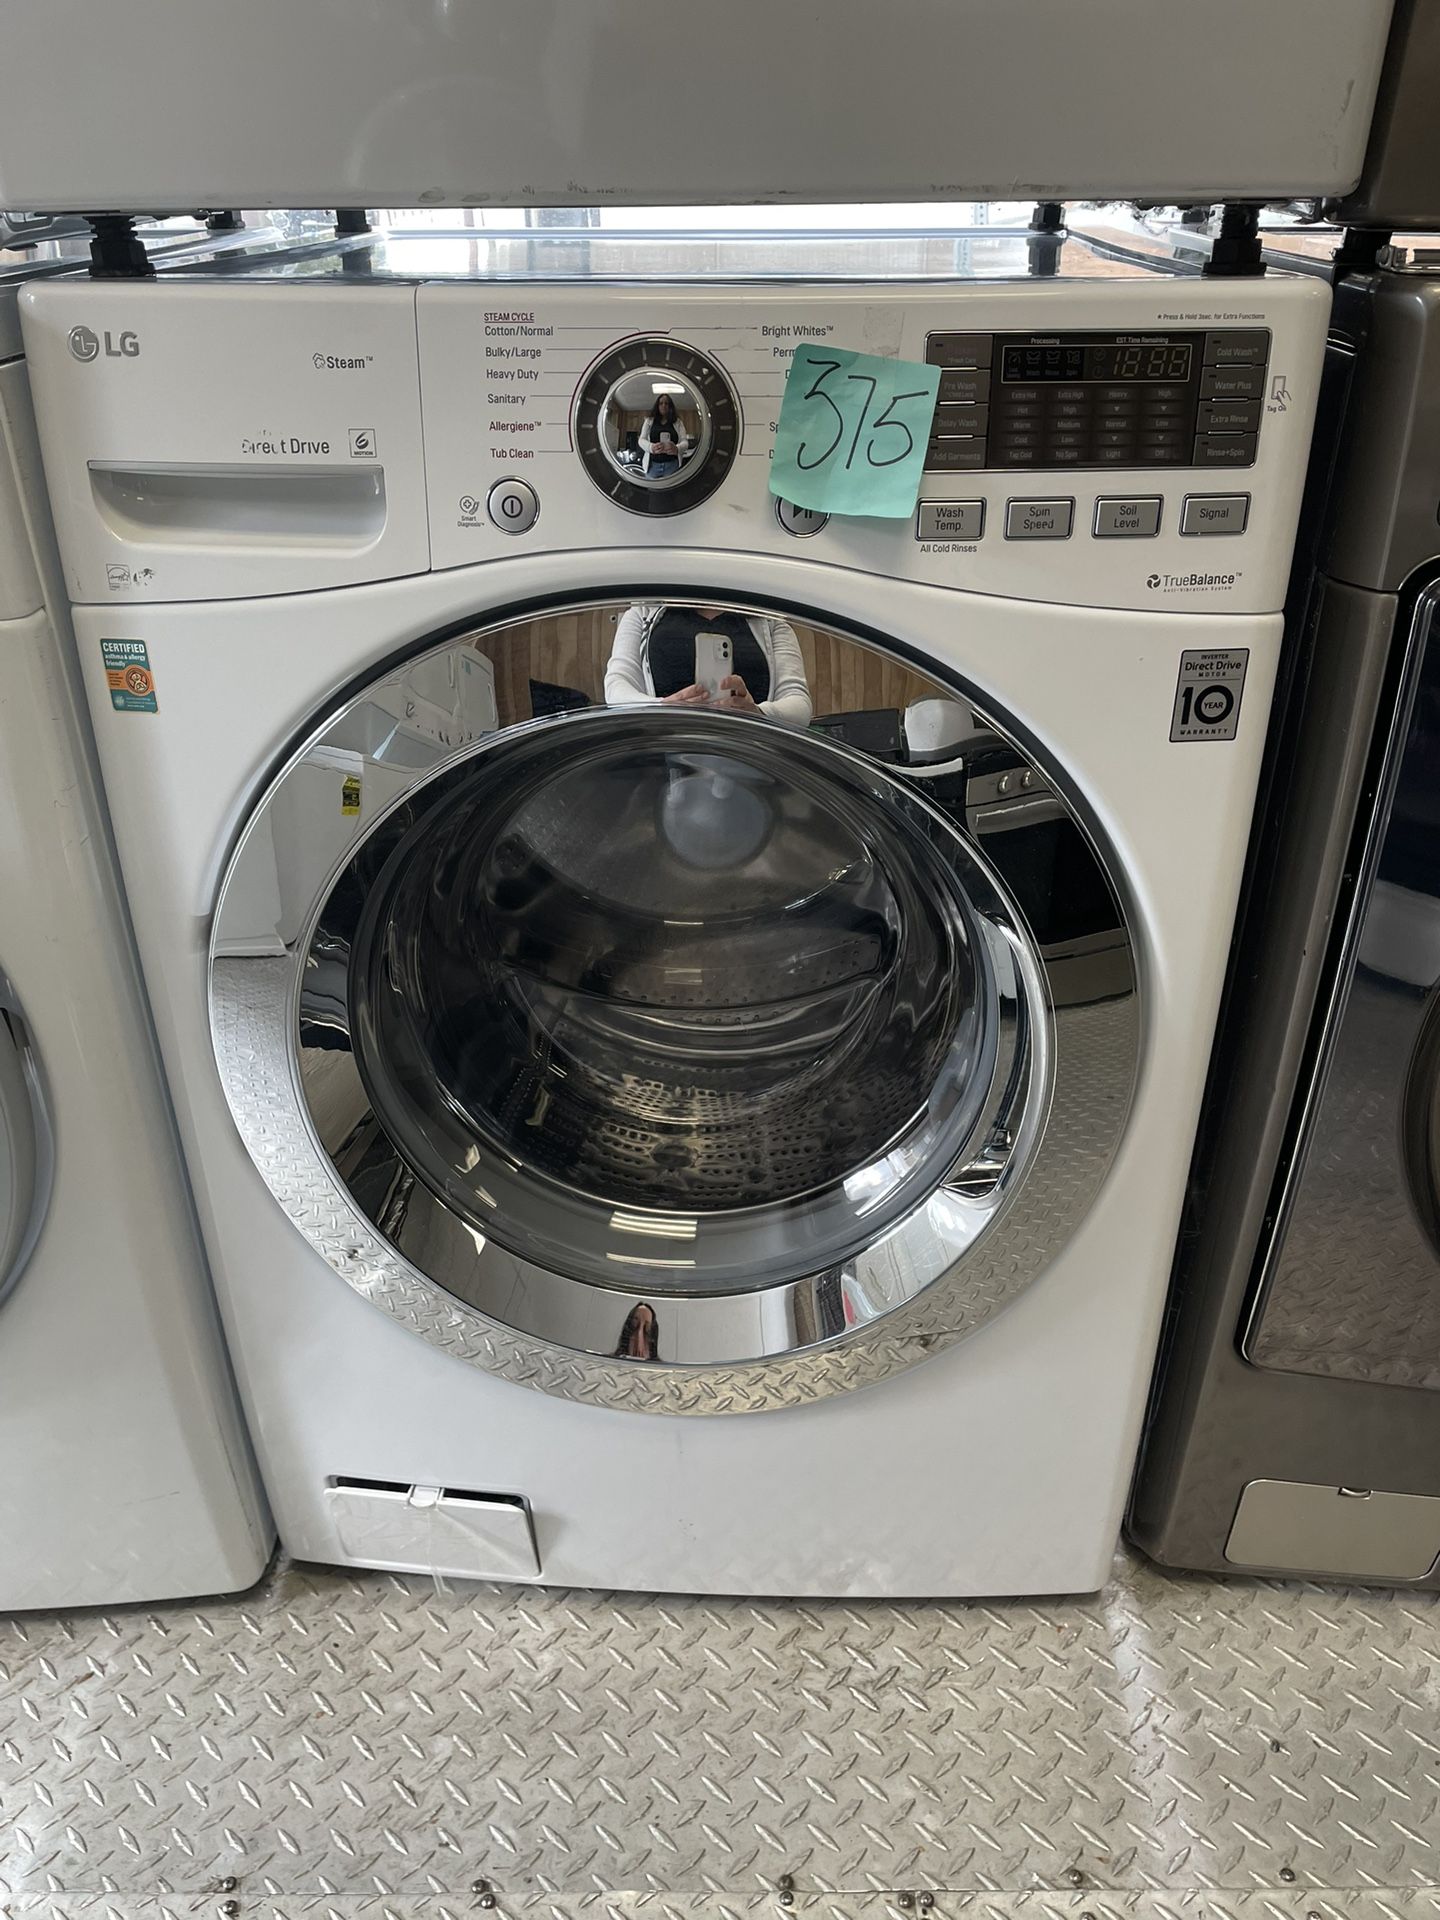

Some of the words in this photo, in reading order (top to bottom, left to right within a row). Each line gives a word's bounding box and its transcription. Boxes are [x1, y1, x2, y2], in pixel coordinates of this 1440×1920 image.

[484, 313, 511, 321] STEAM
[511, 313, 534, 321] CYCLE
[484, 326, 554, 336] Cotton/Normal
[762, 326, 791, 338] Bright
[104, 331, 140, 357] LG
[1031, 337, 1060, 345] Processing
[1141, 336, 1169, 345] Remaining
[485, 347, 542, 359] Bulky/Large
[486, 369, 515, 381] Heavy
[517, 369, 539, 381] Duty
[1214, 381, 1235, 390] Water
[1237, 381, 1252, 390] Plus
[487, 393, 526, 405] Sanitary
[797, 358, 930, 470] 375
[1266, 405, 1277, 413] Tag
[1210, 415, 1229, 424] Extra
[1230, 414, 1249, 424] Rinse
[290, 438, 330, 454] Drive
[490, 448, 507, 458] Tub
[509, 447, 534, 458] Clean
[1206, 448, 1245, 458] Rinse+Spin
[936, 507, 964, 519] Wash
[1029, 506, 1051, 518] Spin
[1120, 505, 1138, 516] Soil
[1199, 508, 1230, 521] Signal
[935, 520, 964, 533] Temp.
[1023, 519, 1054, 532] Speed
[1114, 518, 1140, 528] Level
[920, 544, 931, 553] All
[932, 544, 950, 553] Cold
[951, 544, 978, 553] Rinses
[102, 642, 145, 653] CERTIFIED
[1184, 661, 1214, 671] Direct
[1215, 660, 1242, 670] Drive
[1181, 685, 1234, 725] 10
[1203, 701, 1224, 709] YEAR
